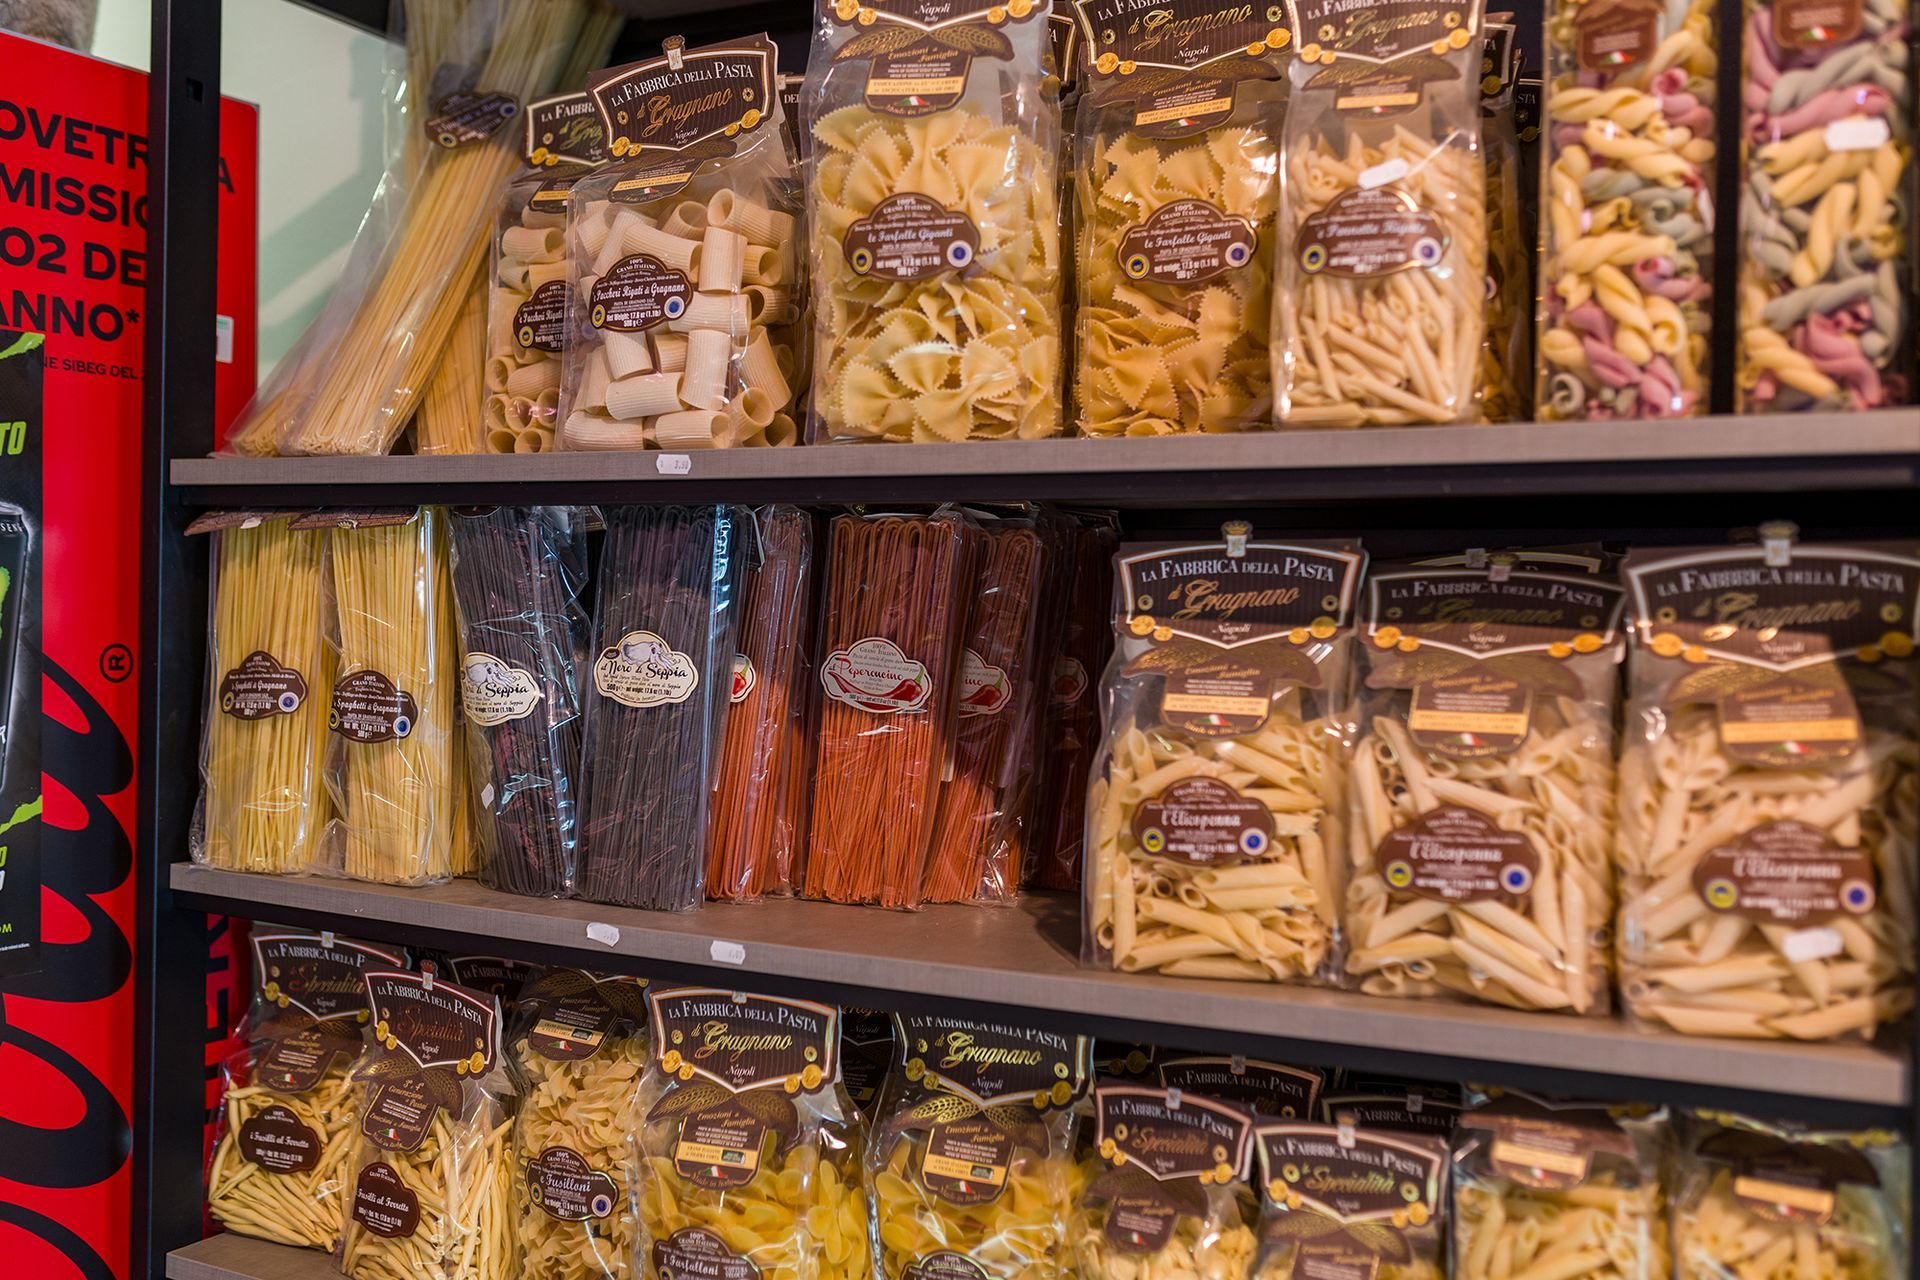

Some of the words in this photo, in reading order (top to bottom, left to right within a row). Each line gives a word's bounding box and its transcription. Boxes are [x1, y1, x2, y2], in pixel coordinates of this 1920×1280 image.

[915, 2, 951, 15] Napoli
[1097, 9, 1114, 21] LA
[1133, 4, 1253, 51] Gragnano
[1174, 45, 1210, 59] Napoli
[610, 95, 624, 108] LA
[621, 72, 683, 101] FABBRICA
[683, 69, 713, 84] DELLA
[713, 61, 755, 79] PASTA
[541, 112, 553, 123] LA
[641, 87, 733, 138] Gragnano
[670, 127, 699, 141] Napoli
[878, 229, 917, 242] Farfalle
[918, 227, 954, 241] Giganti
[1143, 238, 1154, 249] le
[1155, 234, 1195, 248] Farfalle
[1196, 230, 1232, 246] Giganti
[596, 287, 621, 301] Paccheri
[622, 284, 644, 299] Rigati
[650, 282, 685, 297] Gragnano
[62, 358, 106, 377] SIBEG
[109, 364, 138, 381] DEL
[1141, 569, 1158, 583] LA
[1160, 559, 1239, 580] FABBRICA
[1241, 561, 1280, 575] DELLA
[1283, 556, 1334, 582] PASTA
[1656, 582, 1678, 598] LA
[1680, 567, 1783, 593] FABBRICA
[1784, 569, 1835, 586] DELLA
[1839, 563, 1905, 593] PASTA
[1171, 578, 1301, 620] Gragnano
[1391, 587, 1409, 599] LA
[1413, 580, 1500, 597] FABBRICA
[1501, 584, 1544, 598] DELLA
[1548, 583, 1604, 608] PASTA
[1213, 622, 1251, 635] Napoli
[608, 660, 632, 675] Nero
[645, 662, 689, 681] Seppia
[485, 682, 530, 698] Seppia
[336, 698, 367, 711] Spaghetti
[372, 702, 402, 715] Gragnano
[268, 948, 279, 958] LA
[279, 943, 331, 961] FABBRICA
[377, 985, 387, 996] LA
[386, 981, 431, 1003] FABBRICA
[431, 997, 454, 1010] DELLA
[454, 999, 483, 1026] PASTA
[668, 1007, 681, 1020] LA
[682, 1000, 742, 1019] FABBRICA
[744, 1007, 774, 1023] DELLA
[777, 1006, 818, 1033] PASTA
[691, 1023, 702, 1037] di
[990, 1023, 1022, 1039] DELLA
[1025, 1028, 1068, 1052] PASTA
[694, 1020, 793, 1063] Gragnano
[940, 1031, 1043, 1074] Gragnano
[725, 1063, 757, 1078] Napoli
[1186, 1069, 1239, 1086] FABBRICA
[971, 1076, 1004, 1090] Napoli
[1121, 1099, 1172, 1120] FABBRICA
[1200, 1111, 1234, 1140] PASTA
[254, 1131, 275, 1144] Fusilli
[276, 1135, 284, 1145] al
[556, 1151, 570, 1159] 100%
[1287, 1138, 1349, 1161] FABBRICA
[1382, 1149, 1423, 1179] PASTA
[545, 1174, 592, 1193] Fusilloni
[376, 1195, 384, 1205] al
[689, 1232, 705, 1241] 100%
[669, 1255, 719, 1276] Farfalloni
